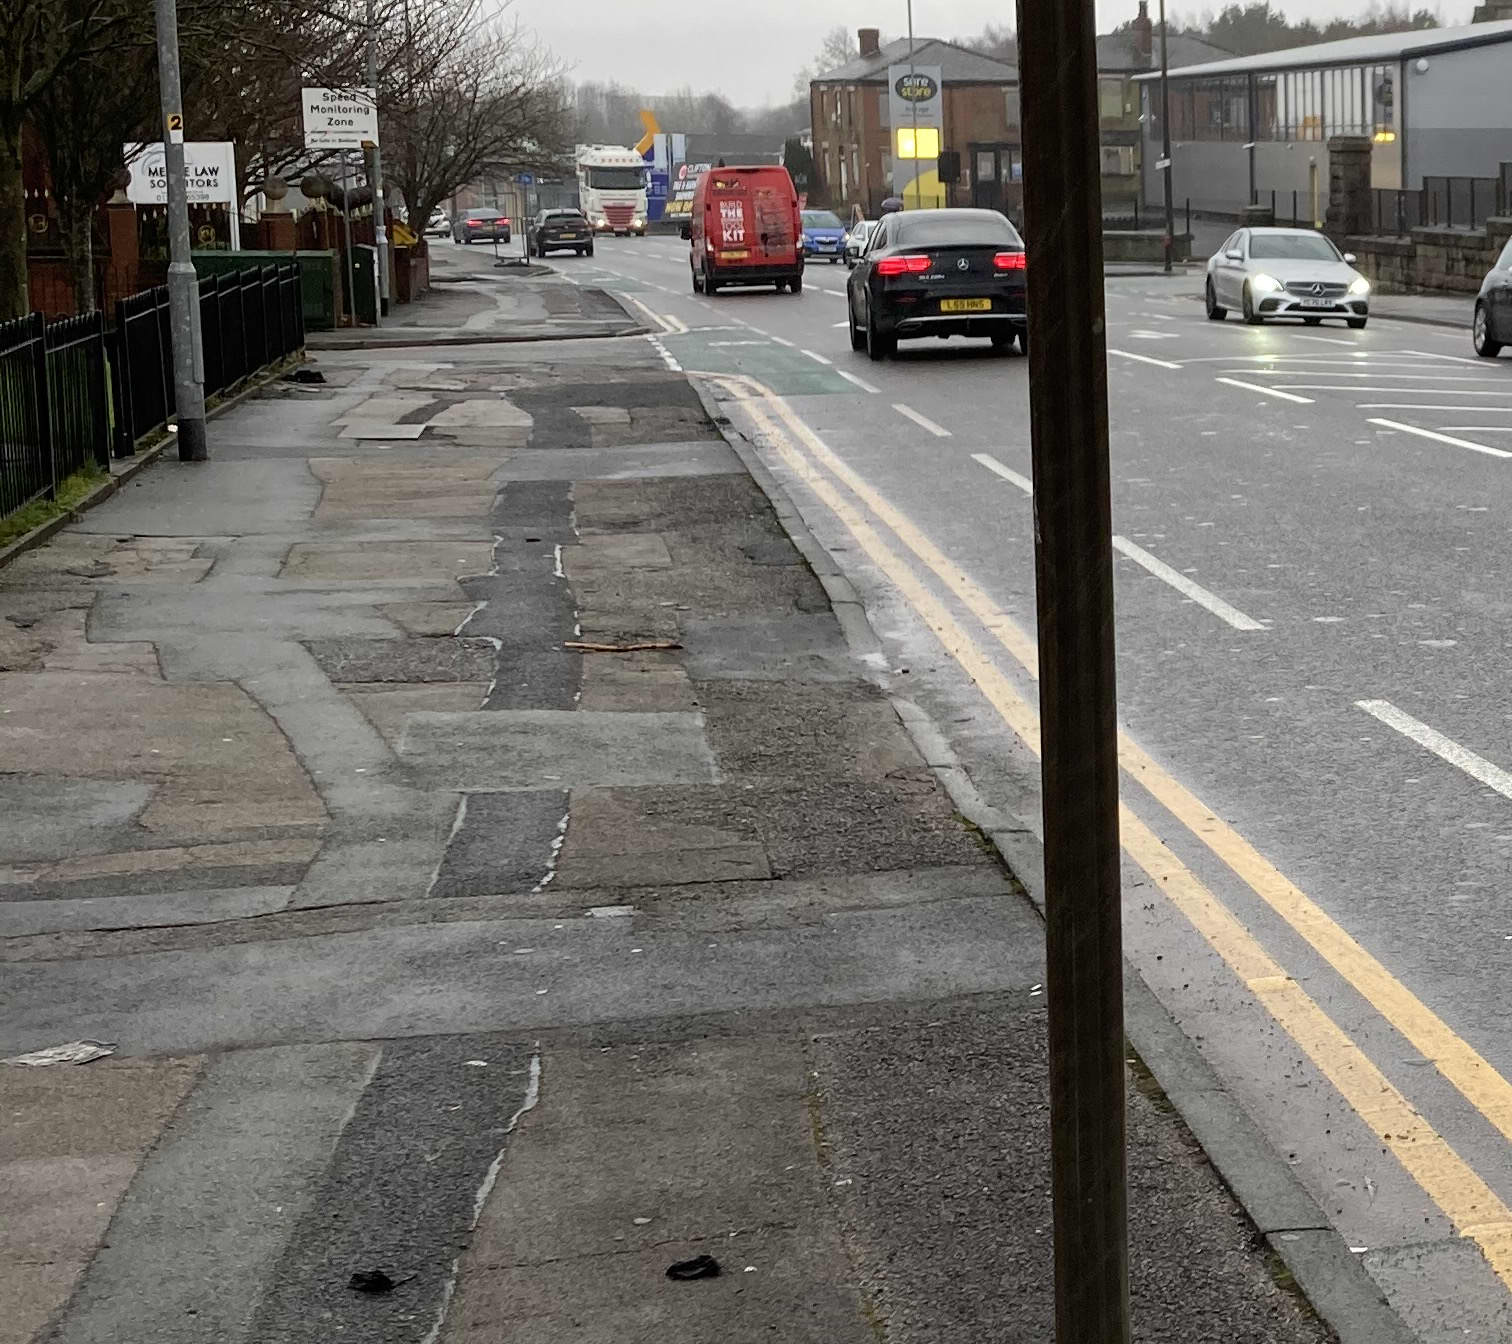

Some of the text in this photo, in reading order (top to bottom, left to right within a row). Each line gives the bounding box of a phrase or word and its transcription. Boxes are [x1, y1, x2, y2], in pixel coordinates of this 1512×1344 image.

[322, 92, 357, 103] Speed
[310, 104, 370, 116] Monitoring
[170, 115, 182, 131] 2
[327, 117, 354, 126] Zone
[194, 166, 220, 177] LAW
[150, 178, 219, 189] SOITORS
[722, 230, 745, 241] KIT
